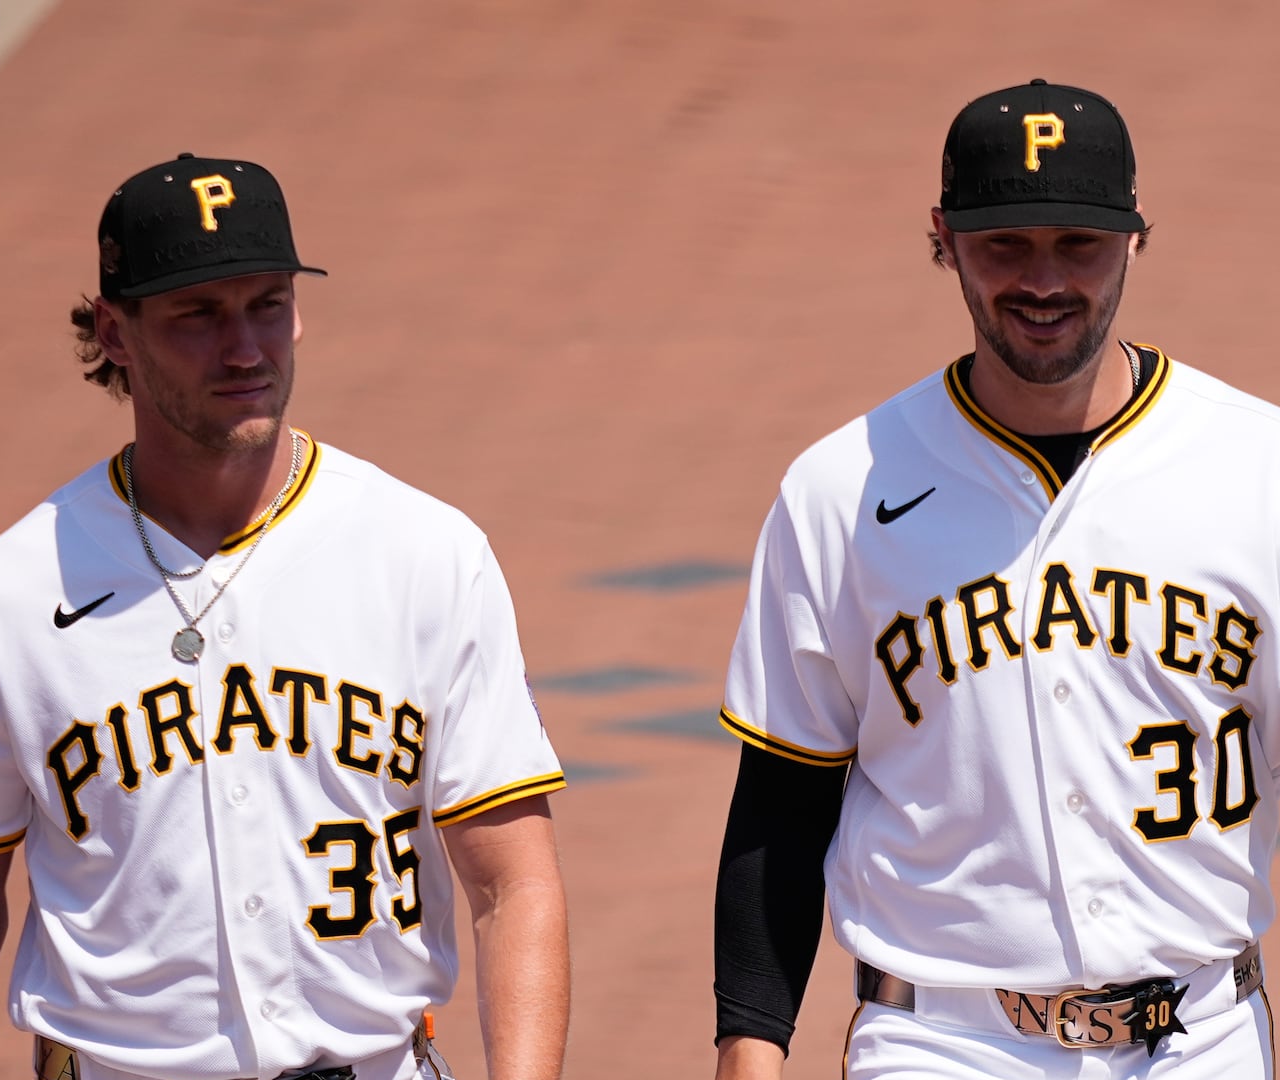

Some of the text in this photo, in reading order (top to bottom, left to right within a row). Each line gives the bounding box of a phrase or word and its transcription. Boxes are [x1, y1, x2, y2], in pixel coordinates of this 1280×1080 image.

[191, 174, 237, 232] P
[1023, 112, 1066, 173] P
[875, 562, 1263, 728] PIRATES
[47, 663, 425, 842] PIRATES
[1126, 705, 1261, 844] 30
[301, 807, 423, 941] 35
[1145, 1000, 1170, 1031] 30
